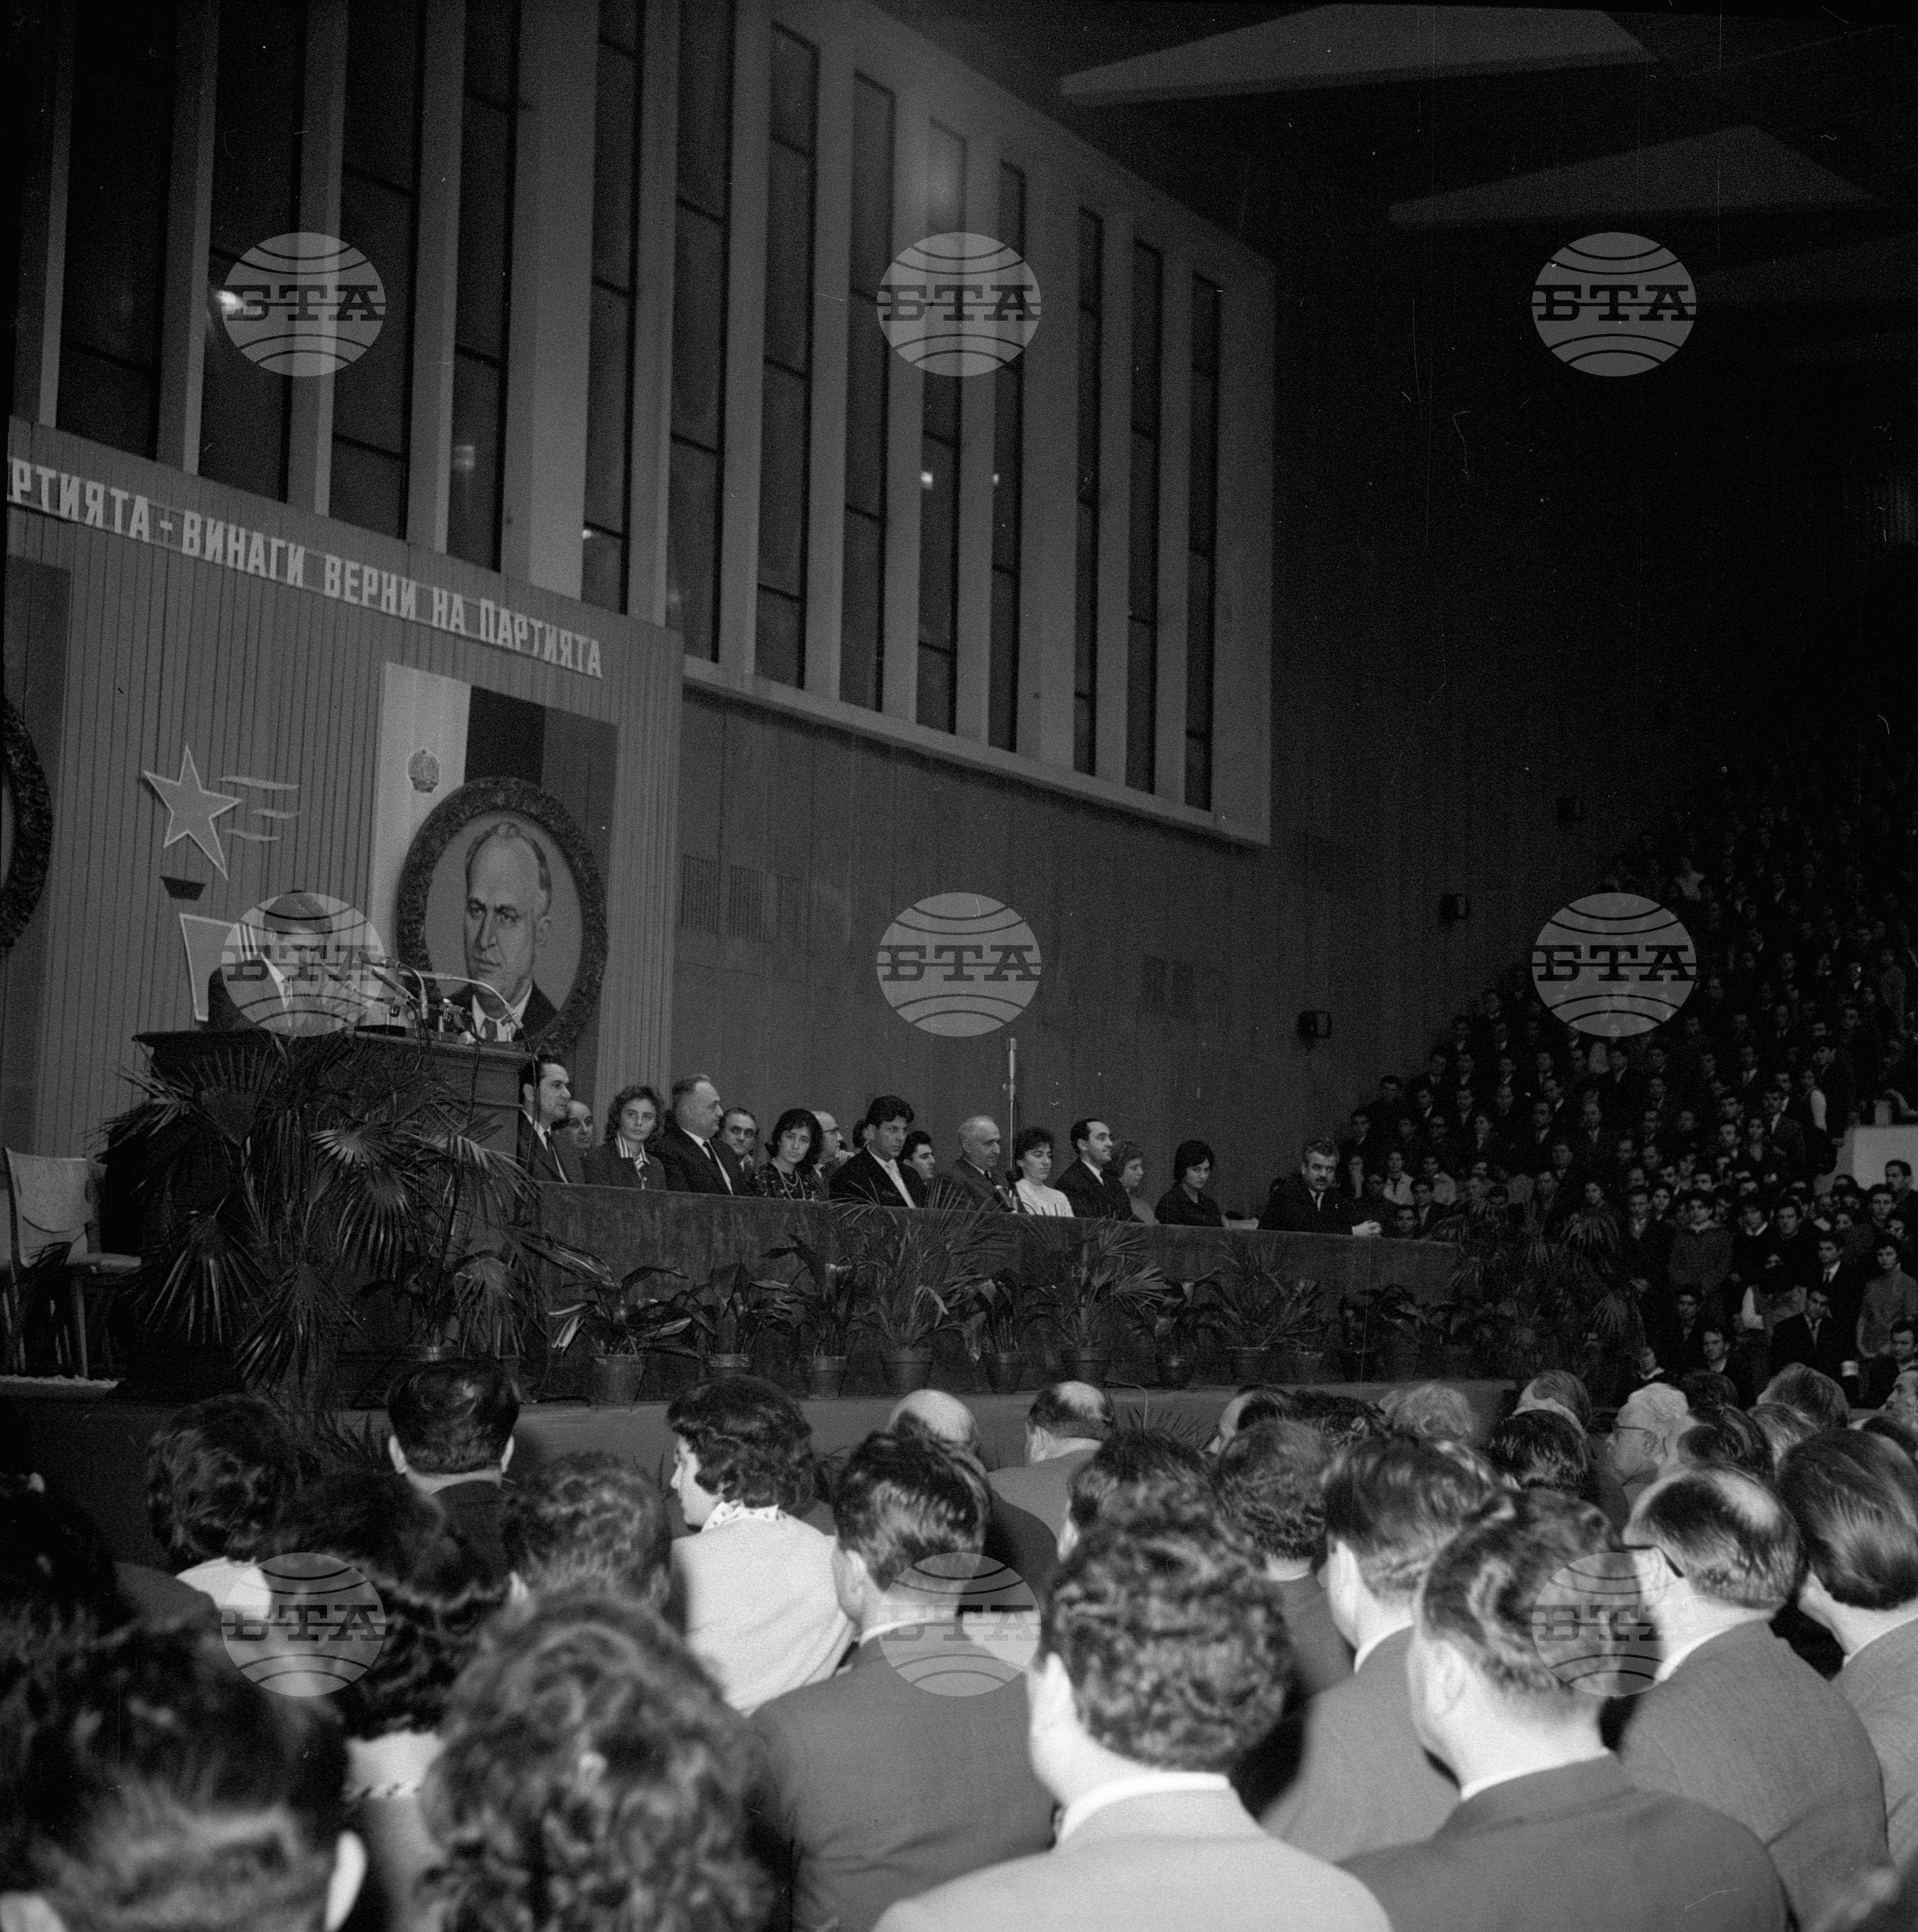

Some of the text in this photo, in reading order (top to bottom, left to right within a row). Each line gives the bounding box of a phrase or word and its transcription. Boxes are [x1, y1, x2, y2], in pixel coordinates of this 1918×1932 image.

[9, 458, 150, 543] РТИЯТА
[182, 510, 305, 589] ВИНАГИ
[324, 554, 416, 621] ВЕРНИ
[432, 587, 466, 635] НА
[480, 598, 602, 679] ПАРТИЯТА
